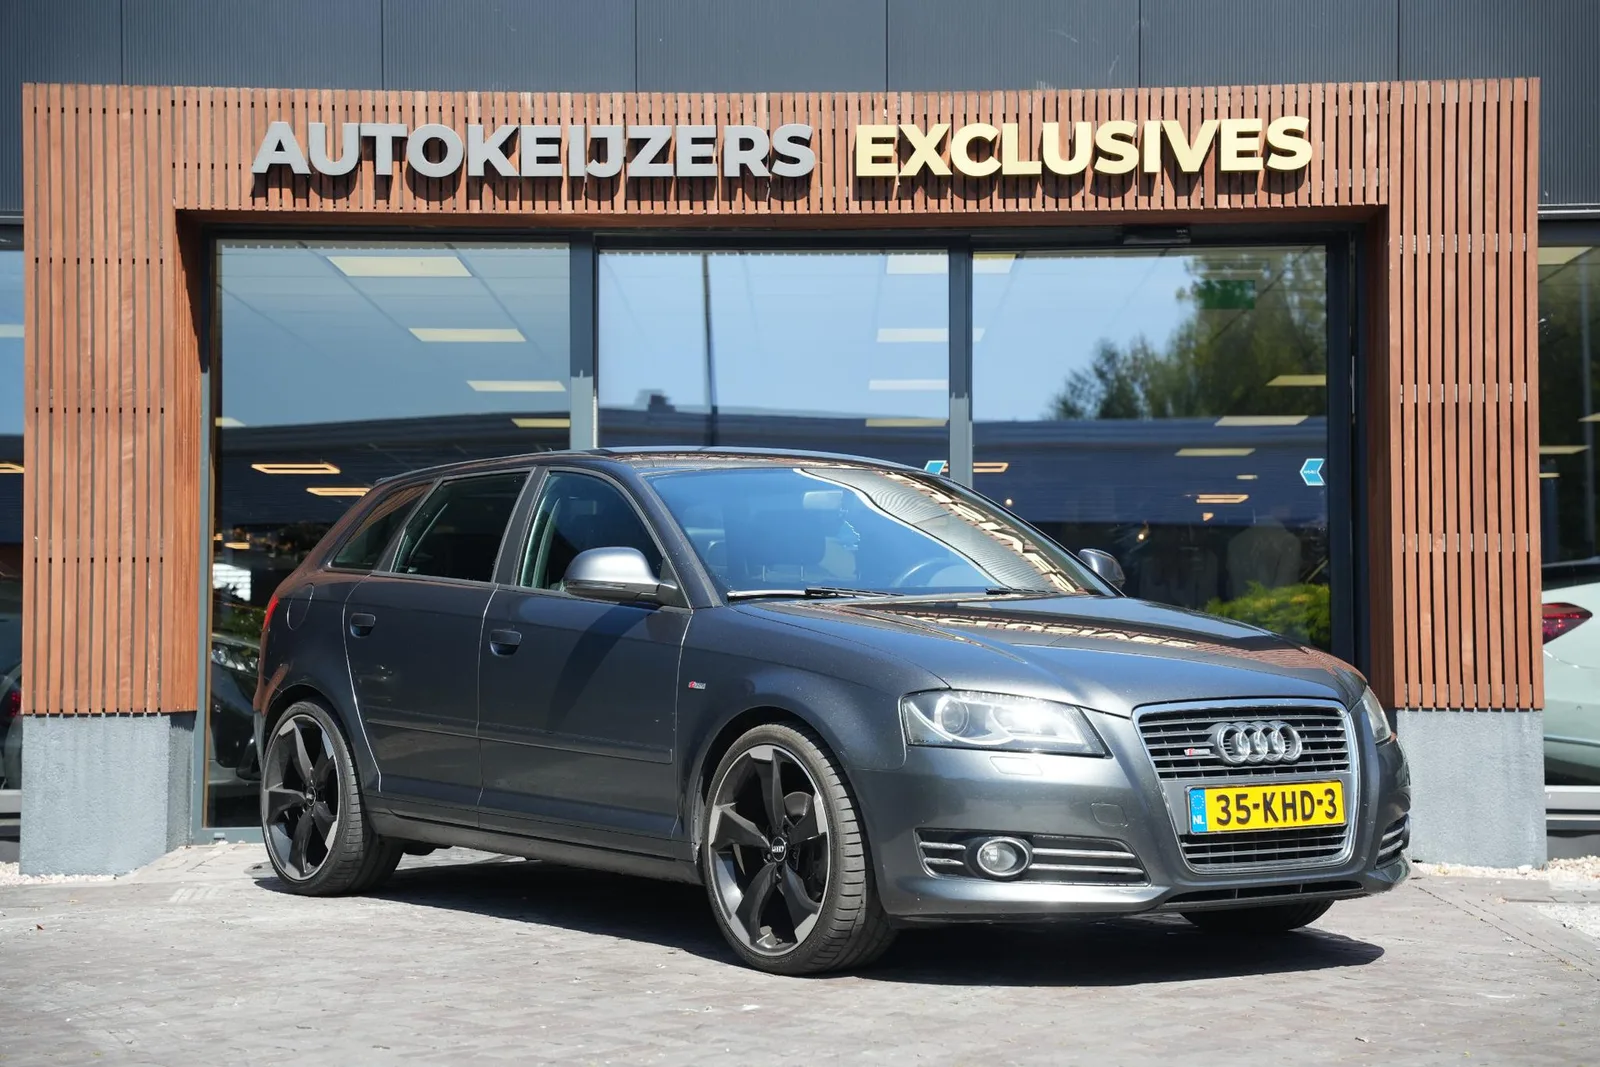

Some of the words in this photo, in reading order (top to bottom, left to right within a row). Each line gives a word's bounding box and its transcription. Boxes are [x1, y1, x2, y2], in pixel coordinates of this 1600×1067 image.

[252, 121, 816, 178] AUTOKEIJZERS
[855, 115, 1313, 177] EXCLUSIVES
[1192, 816, 1205, 825] NL
[1216, 788, 1337, 825] 35-KHD-3
